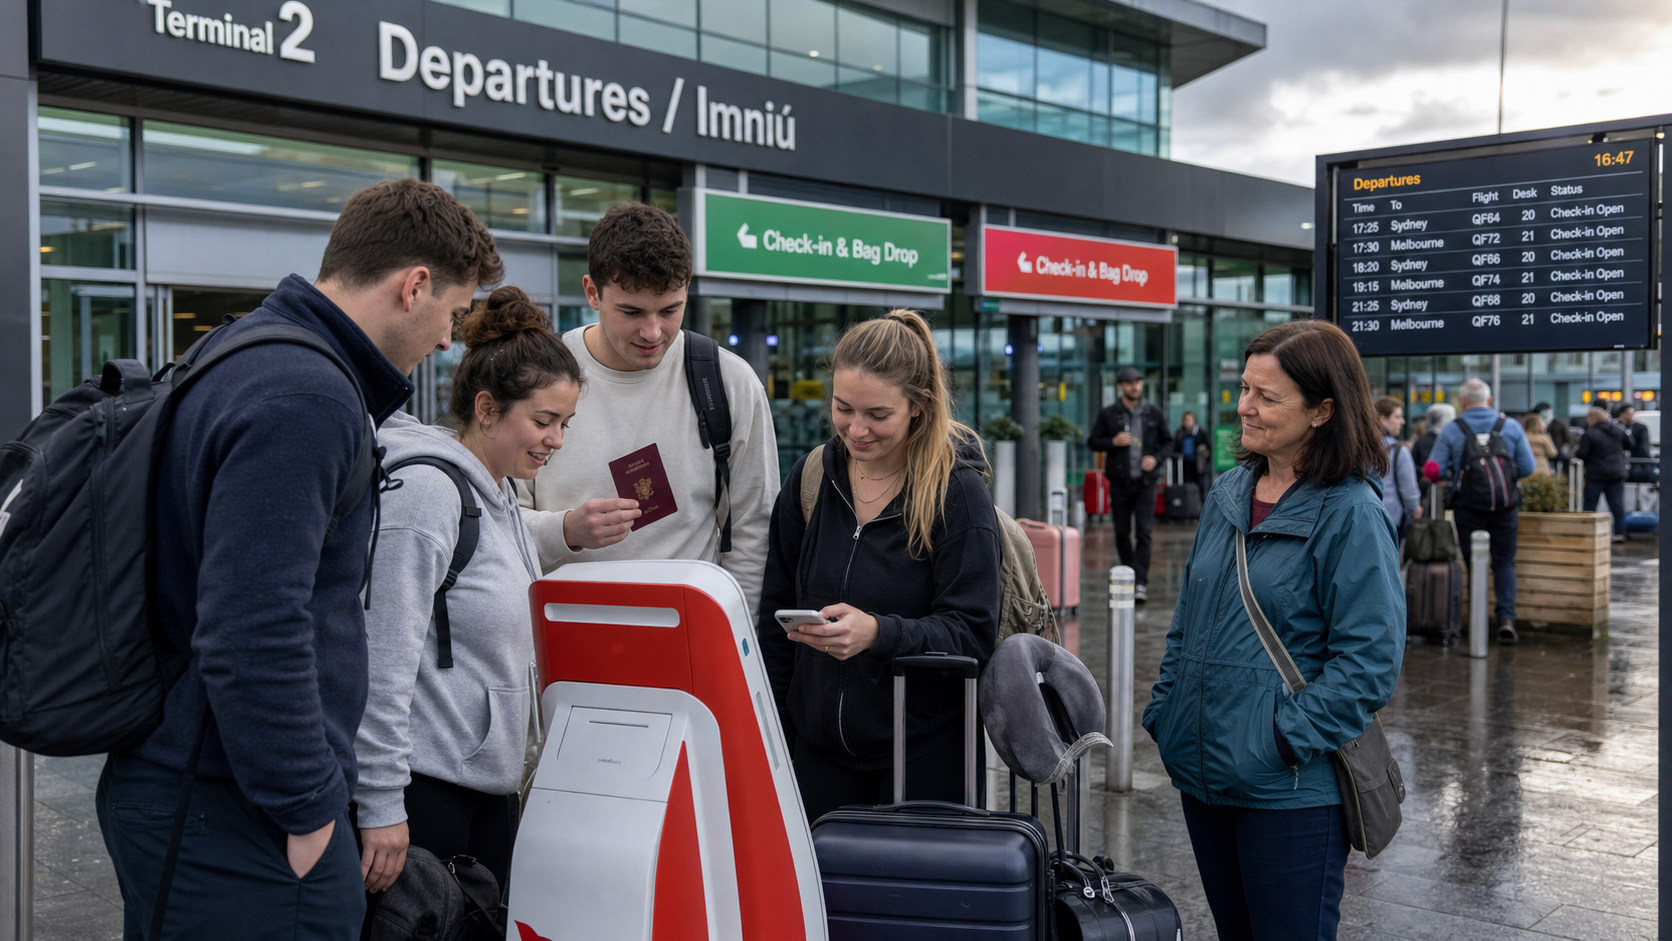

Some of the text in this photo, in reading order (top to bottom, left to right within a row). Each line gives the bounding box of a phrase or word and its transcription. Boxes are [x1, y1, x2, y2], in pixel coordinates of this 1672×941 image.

[146, 0, 316, 63] Terminal 2
[379, 20, 796, 151] Departures / Imniú
[1353, 150, 1635, 192] Departures 16:47
[1352, 183, 1583, 214] Time To Flight Desk Status
[1352, 203, 1624, 235] 17:25 Sydney QF64 20 Check-in Open
[763, 229, 919, 268] Check-in & Bag Drop
[1352, 225, 1624, 254] 17:30 Melbourne QF72 21 Check-in Open
[1036, 255, 1149, 287] Check-in & Bag Drop
[1352, 246, 1624, 274] 18:20 Sydney QF66 20 Check-in Open
[1352, 267, 1624, 293] 19:15 Melbourne QF74 21 Check-in Open
[1352, 289, 1624, 314] 21:25 Sydney QF68 20 Check-in Open
[1352, 310, 1624, 332] 21:30 Melbourne QF76 21 Check-in Open
